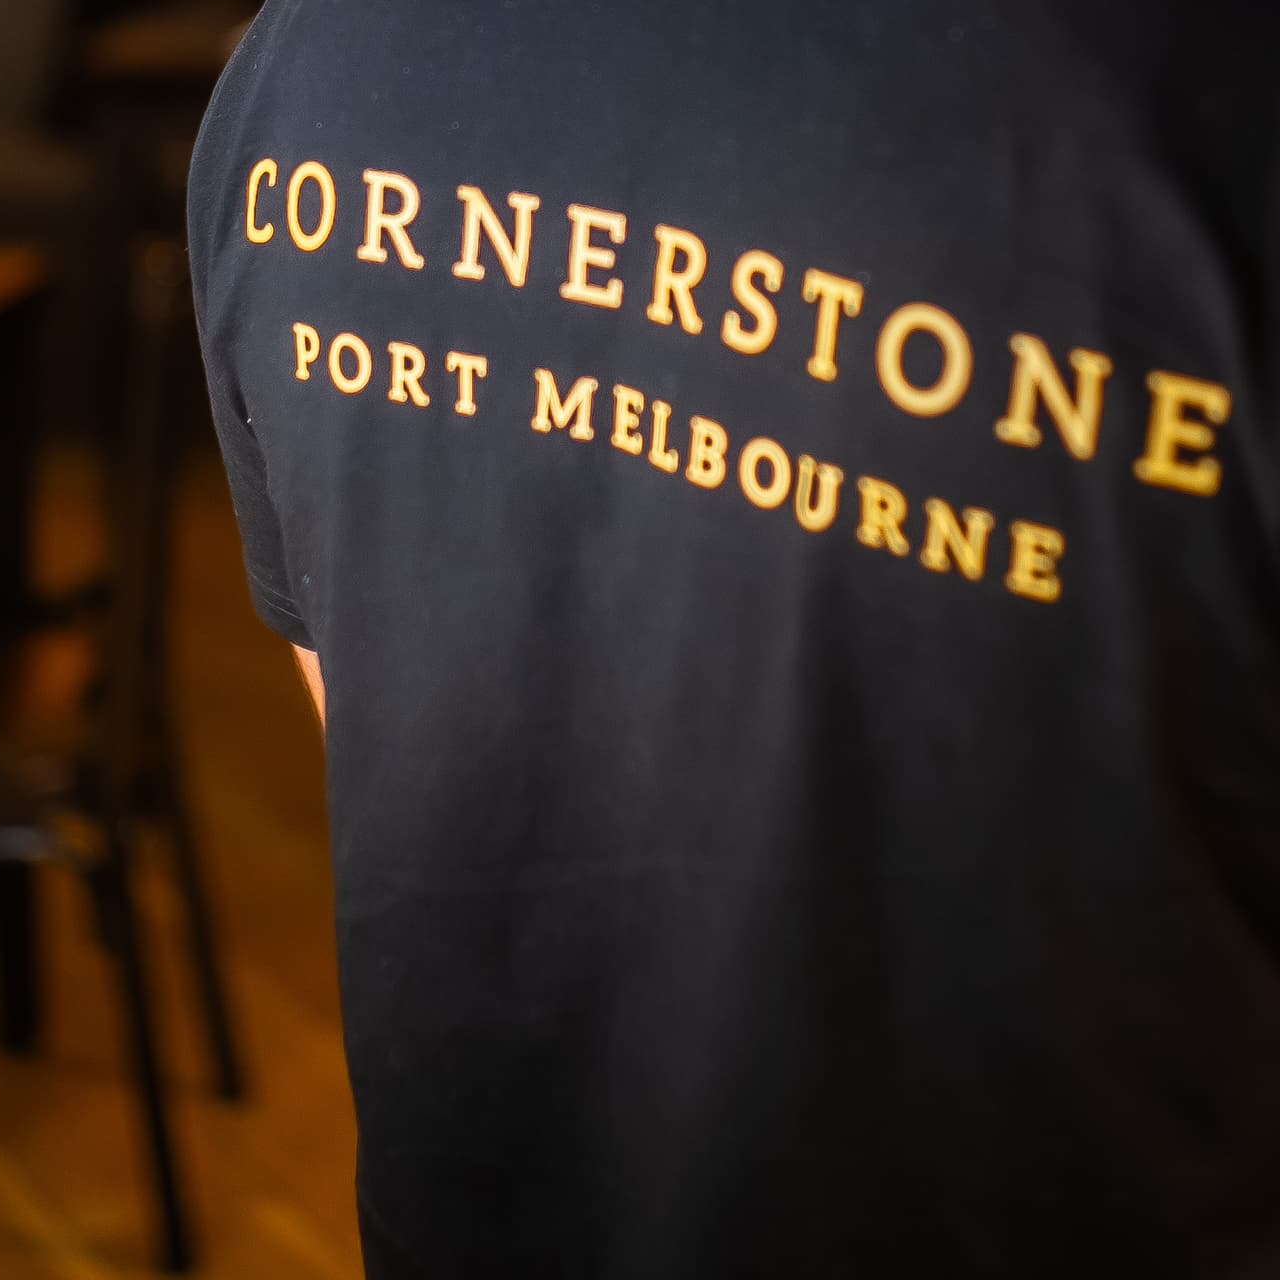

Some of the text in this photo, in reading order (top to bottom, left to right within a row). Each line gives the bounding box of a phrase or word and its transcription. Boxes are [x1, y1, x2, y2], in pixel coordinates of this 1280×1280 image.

[245, 158, 1232, 495] CORNERSTONE
[291, 321, 1066, 601] PORT MELBOURNE
